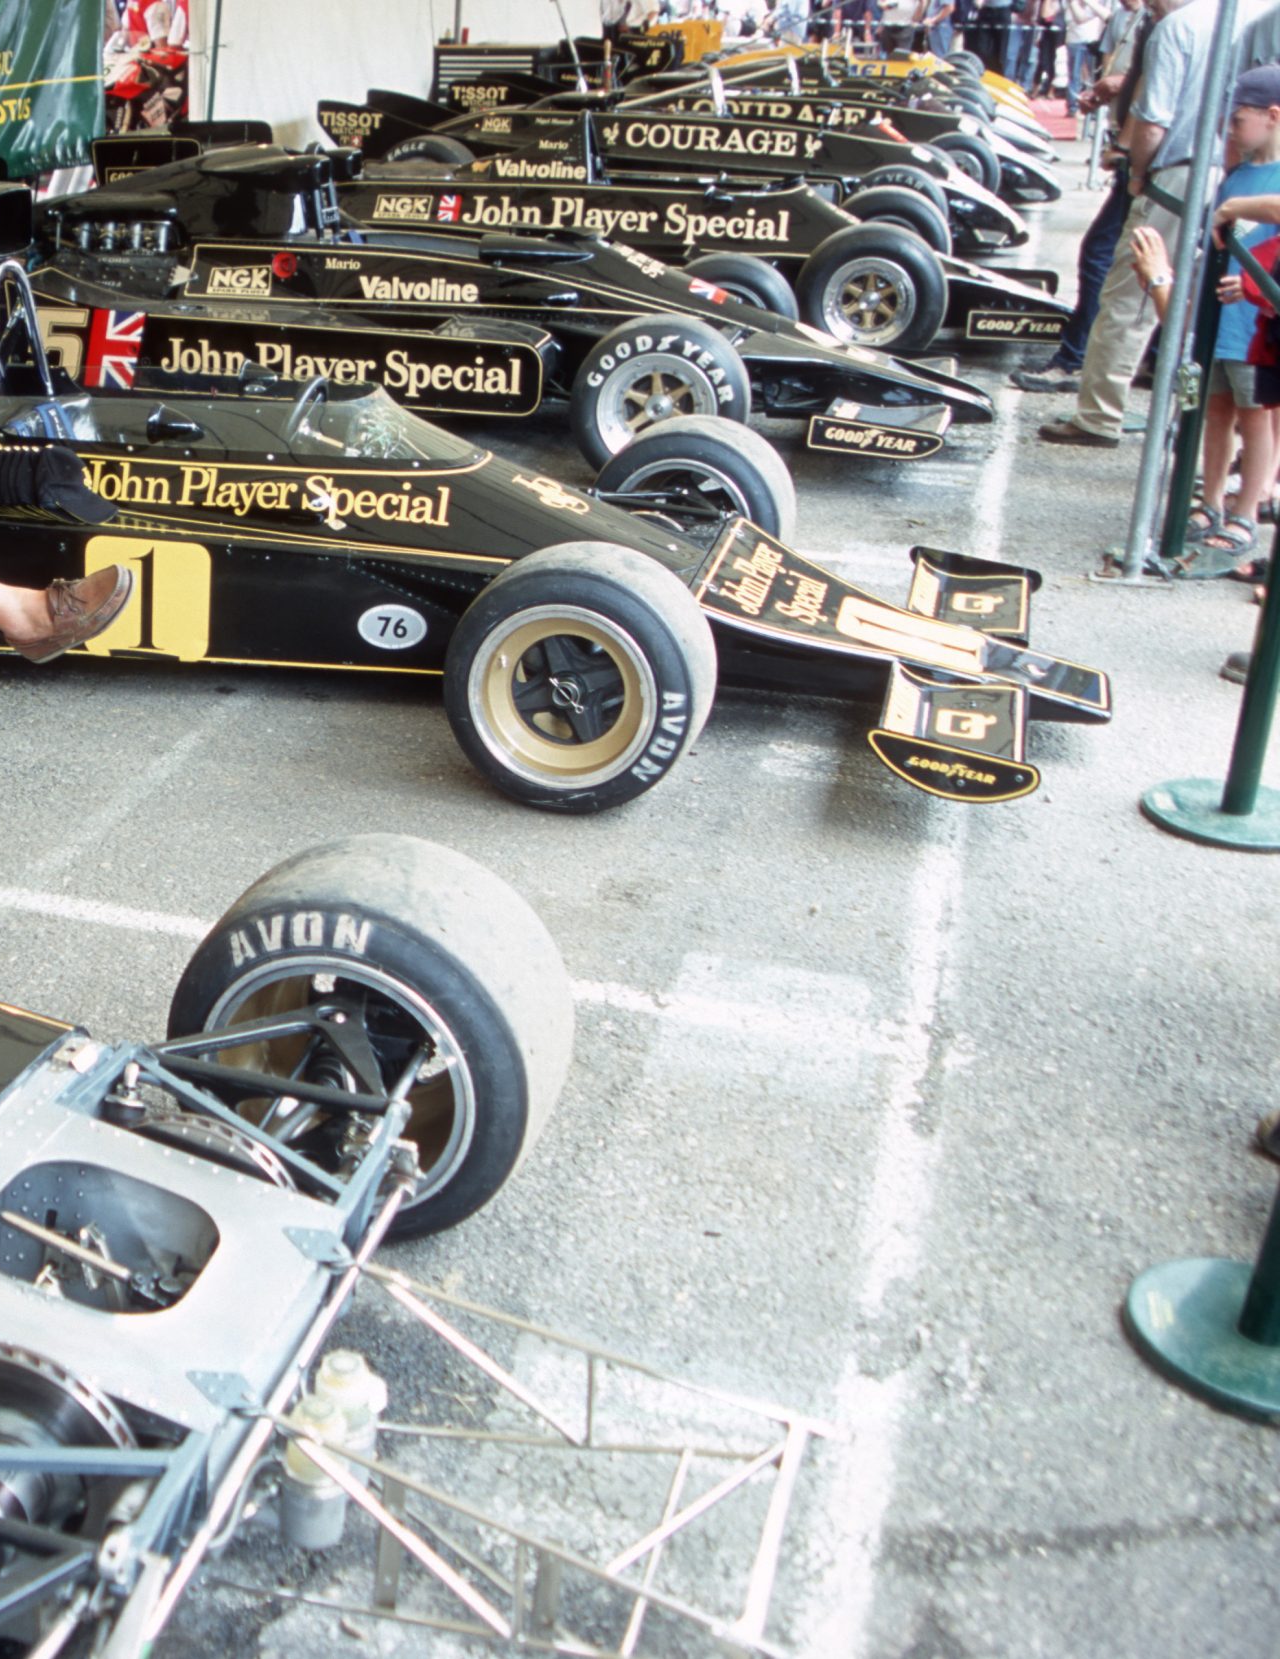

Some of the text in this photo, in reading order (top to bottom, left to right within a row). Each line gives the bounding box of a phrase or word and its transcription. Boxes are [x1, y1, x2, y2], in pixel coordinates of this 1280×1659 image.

[452, 86, 509, 100] TISSOT
[320, 112, 384, 129] TISSOT
[539, 140, 568, 151] Mario
[626, 122, 797, 157] COURAGE
[494, 159, 587, 180] Valvoline
[376, 197, 428, 213] NGK
[462, 195, 791, 245] John Player Special
[325, 257, 362, 271] Mario
[211, 269, 270, 289] NGK
[359, 275, 479, 302] Valvoline
[976, 317, 1063, 334] GOODYEAR
[161, 338, 522, 398] John Player Special
[586, 335, 735, 405] GOODYEAR
[824, 426, 918, 452] GOODYEAR
[88, 460, 450, 527] John Player Special
[129, 546, 164, 650] 1
[377, 616, 407, 639] 76
[631, 691, 687, 783] AVON
[908, 756, 997, 785] GOODYEAR
[230, 911, 371, 968] AVON
